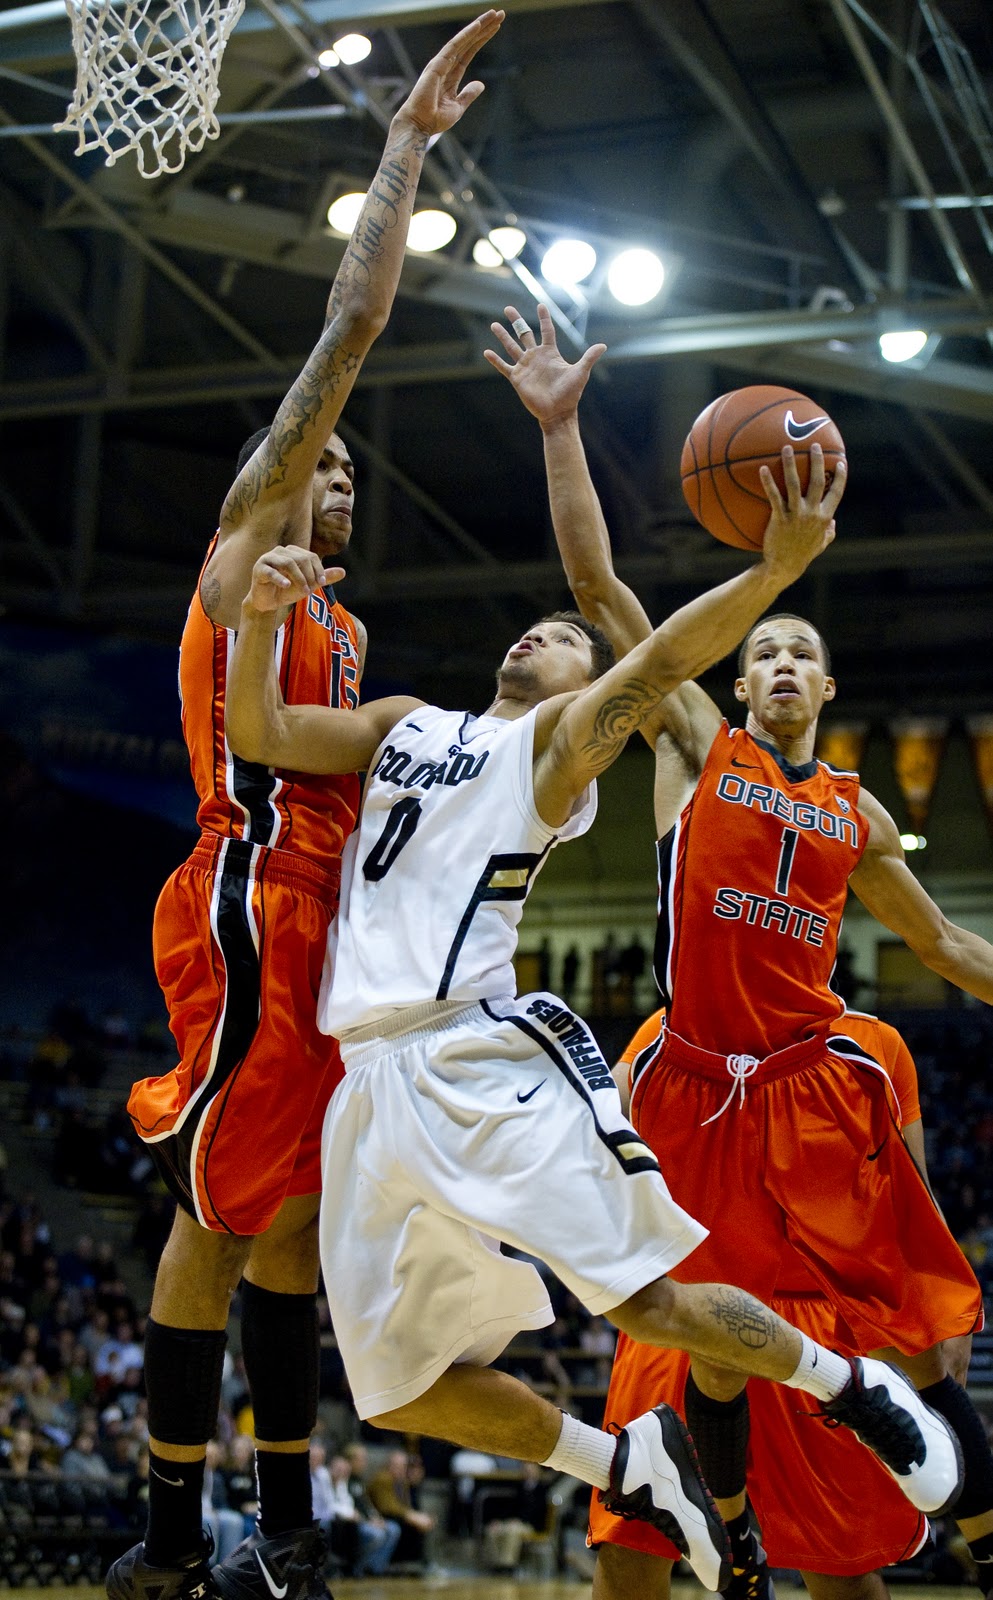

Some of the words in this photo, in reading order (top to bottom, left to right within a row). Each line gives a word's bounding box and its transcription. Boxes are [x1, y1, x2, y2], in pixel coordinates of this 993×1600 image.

[371, 745, 490, 790] COLORADO
[362, 796, 422, 882] 0
[716, 773, 858, 849] OREGON
[775, 827, 800, 896] 1
[713, 887, 829, 947] STATE
[526, 999, 617, 1092] BUFFALOES
